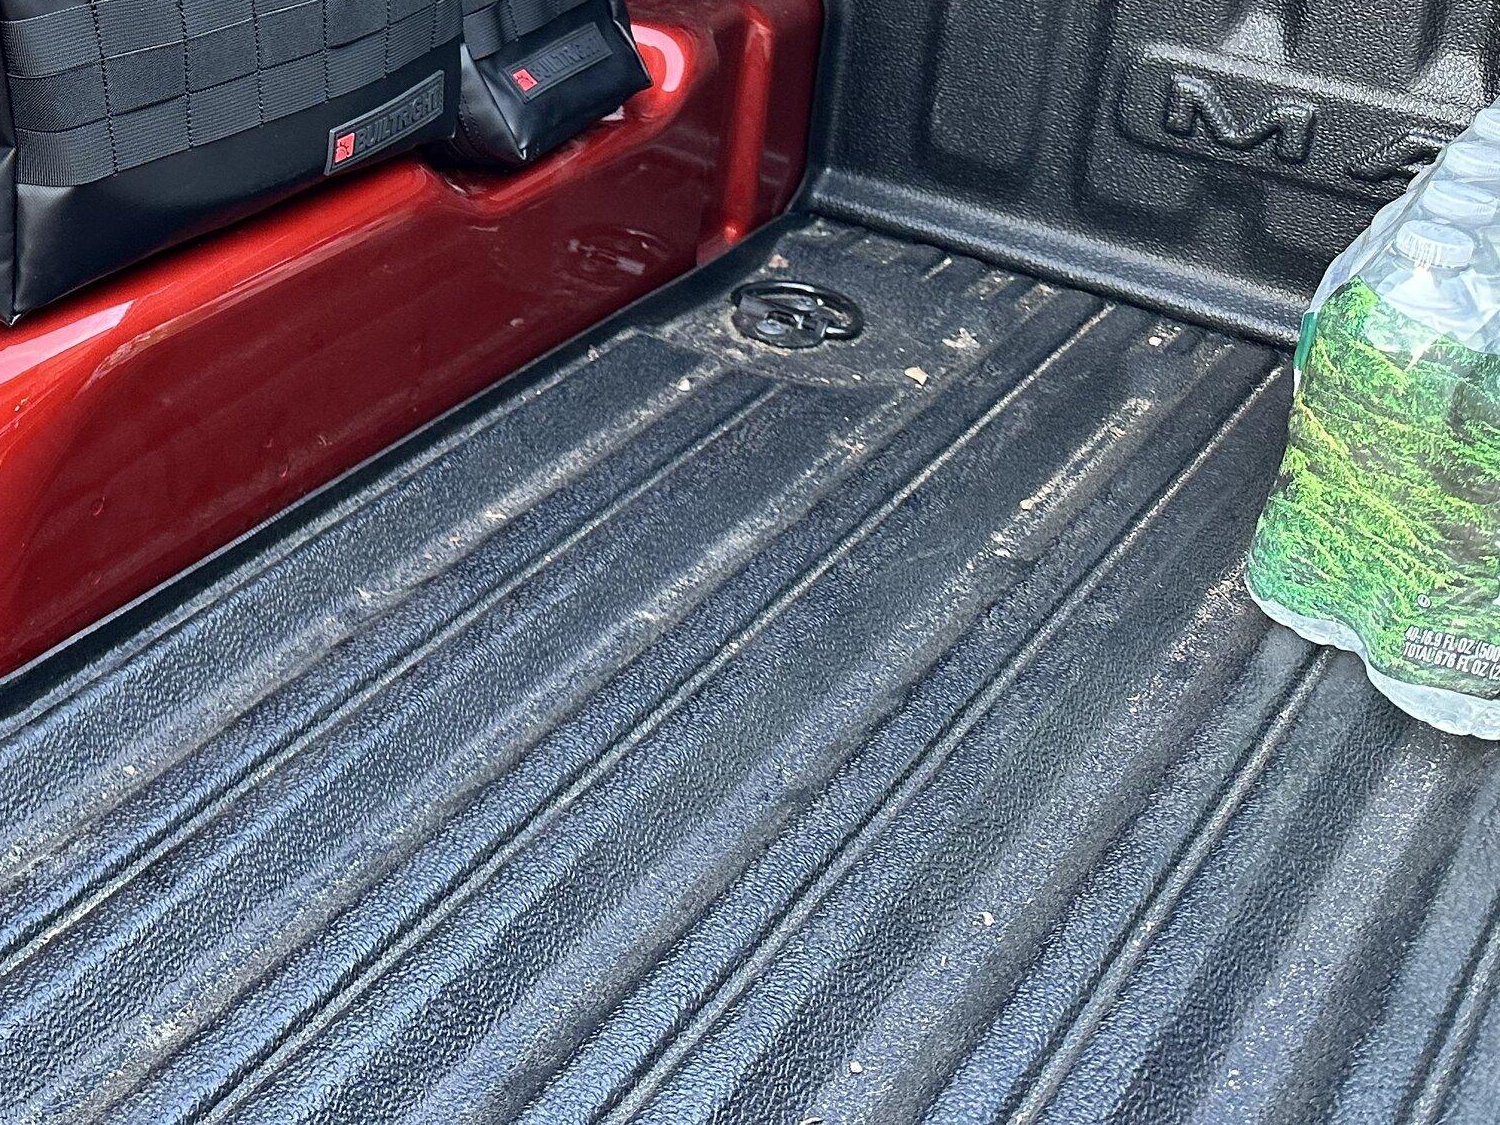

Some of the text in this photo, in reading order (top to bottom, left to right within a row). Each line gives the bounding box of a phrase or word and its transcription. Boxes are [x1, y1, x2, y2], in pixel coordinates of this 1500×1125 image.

[1405, 625, 1443, 647] 40-16.9
[1442, 634, 1455, 651] FL
[1457, 637, 1475, 654] OZ
[1403, 641, 1433, 663] TOTAL
[1434, 649, 1457, 668] 676
[1455, 655, 1469, 673] FL
[1470, 659, 1490, 677] OZ
